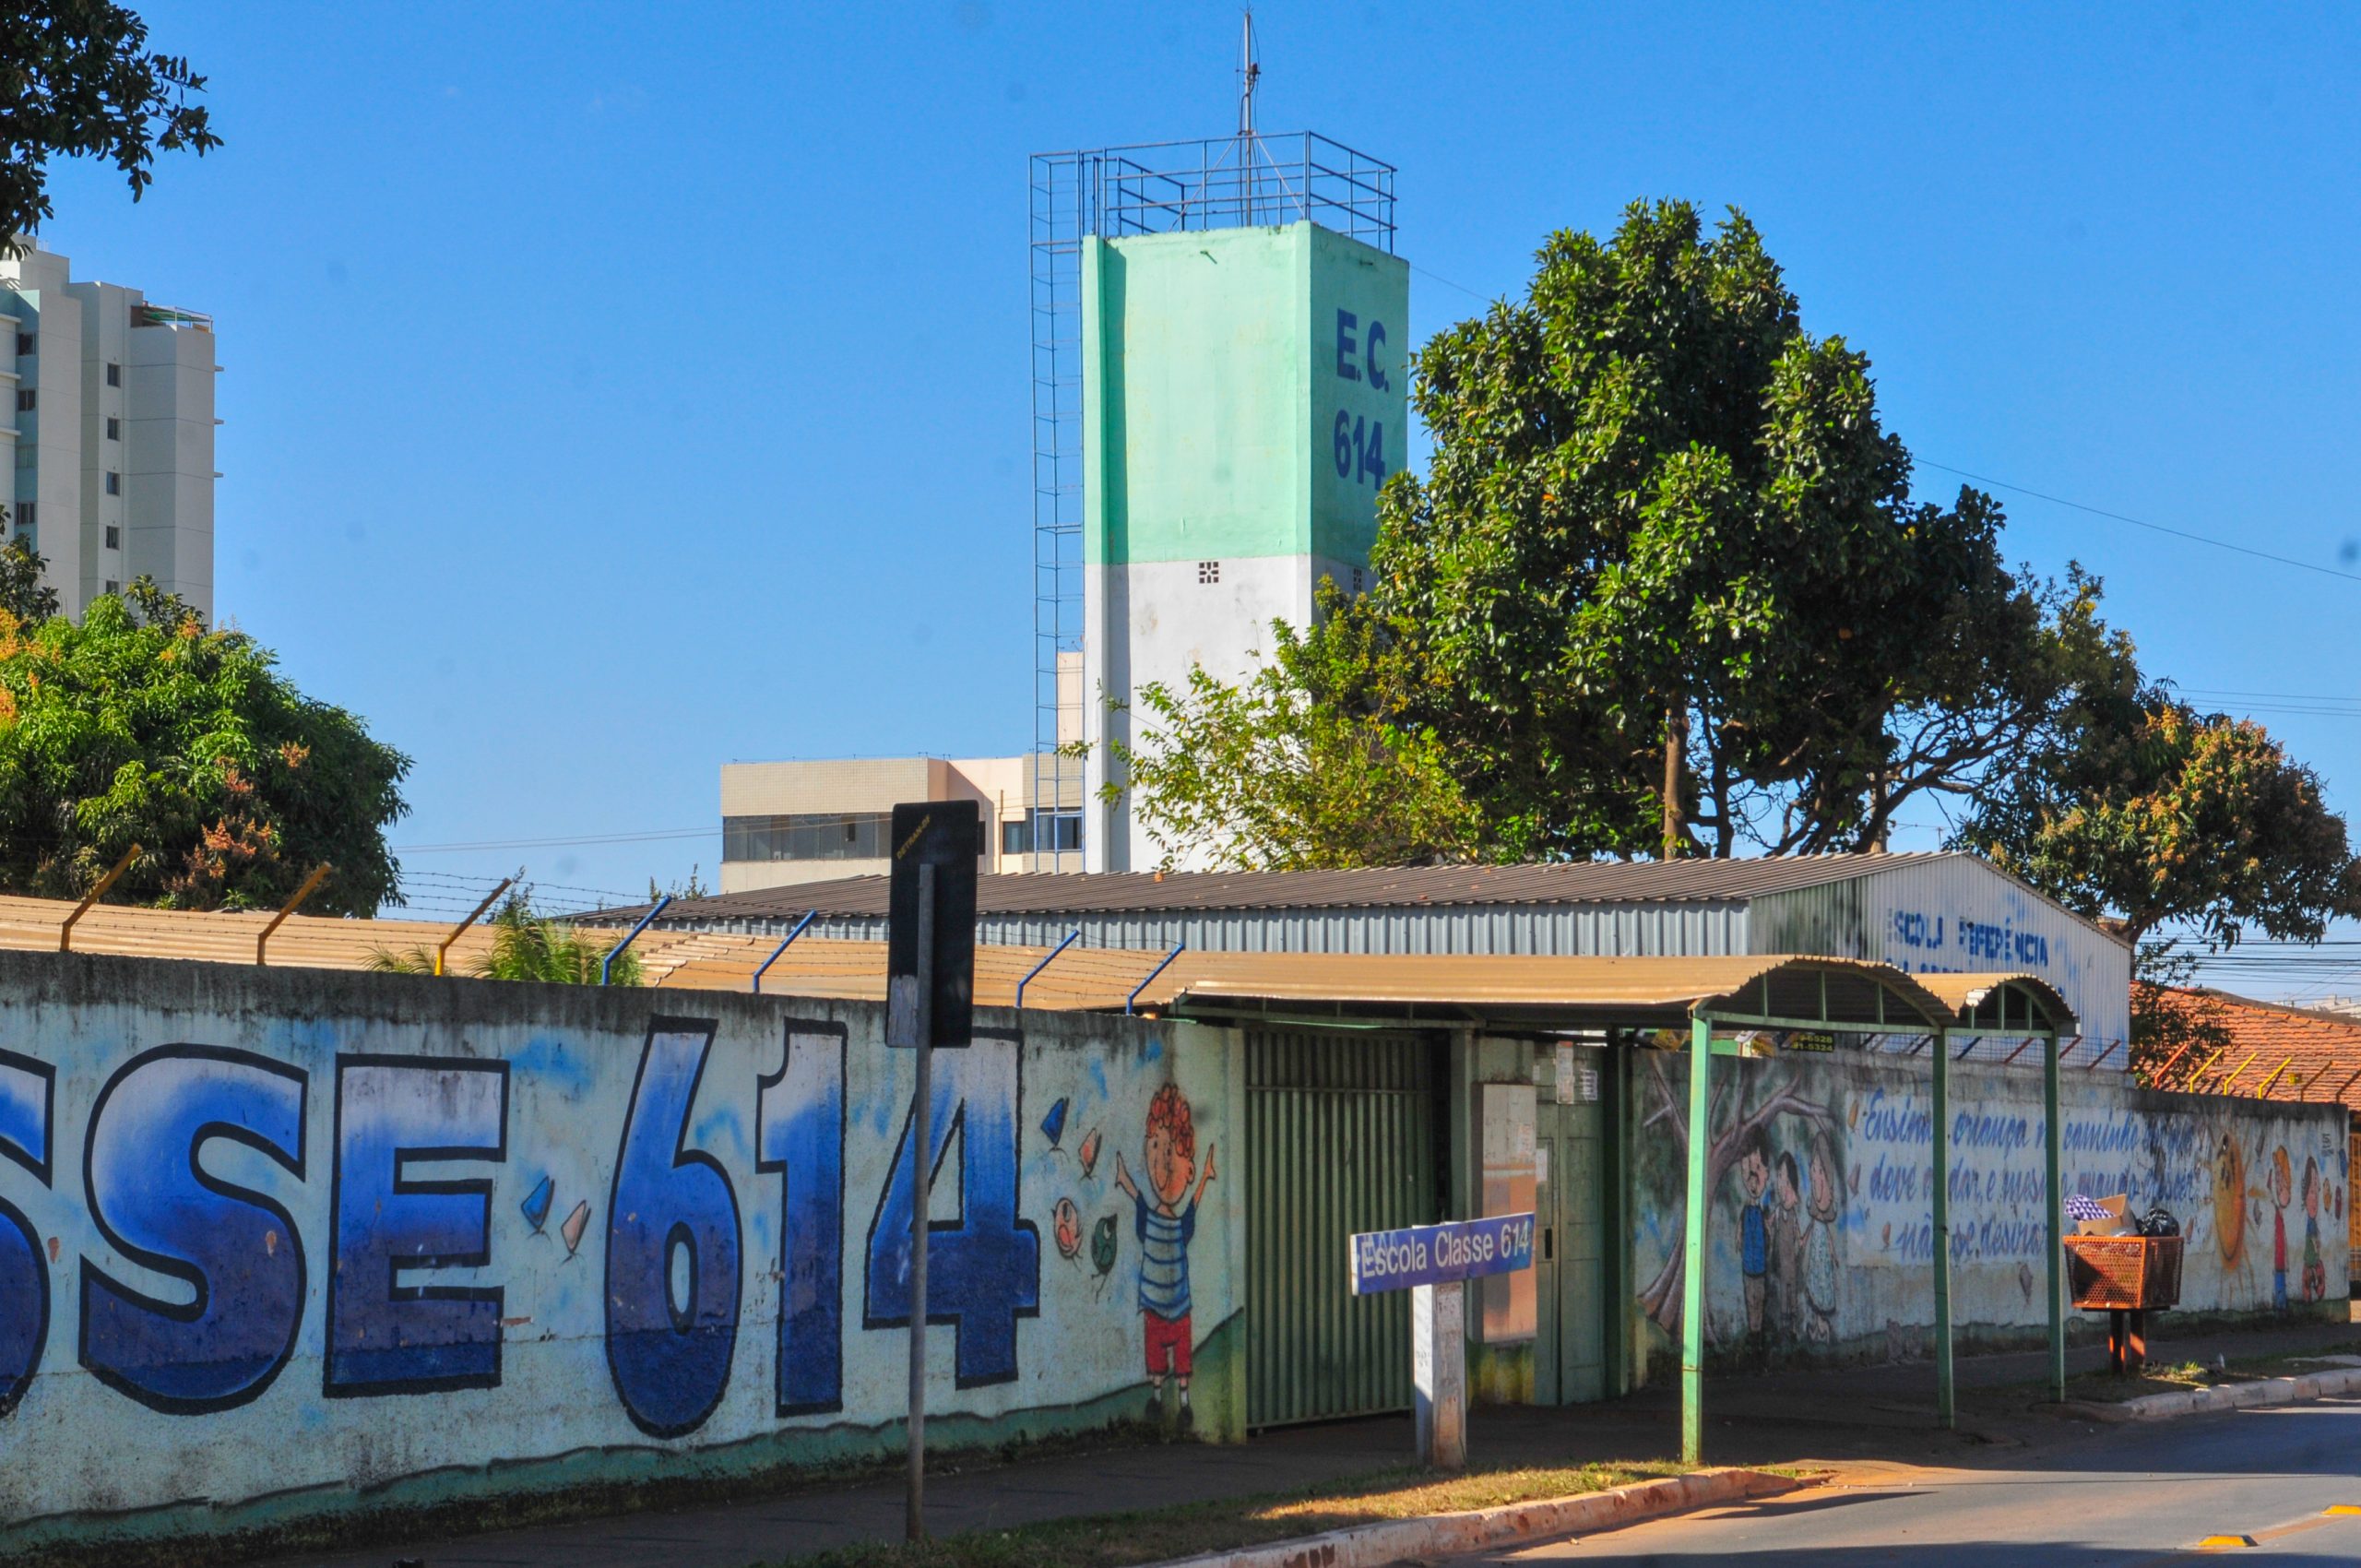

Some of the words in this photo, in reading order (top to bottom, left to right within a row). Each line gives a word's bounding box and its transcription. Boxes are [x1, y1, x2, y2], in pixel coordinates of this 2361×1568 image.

[1336, 307, 1390, 394] E.C.
[1334, 409, 1386, 491] 614
[2063, 1108, 2139, 1152] caminho
[1869, 1152, 1917, 1203] deve
[1923, 1157, 1982, 1206] adar,
[0, 1042, 510, 1417] SE
[604, 1018, 1040, 1439] 614
[1361, 1236, 1427, 1278] Escola
[1435, 1231, 1493, 1268] Classe
[1501, 1220, 1530, 1259] 614
[1896, 1212, 1934, 1262] nã
